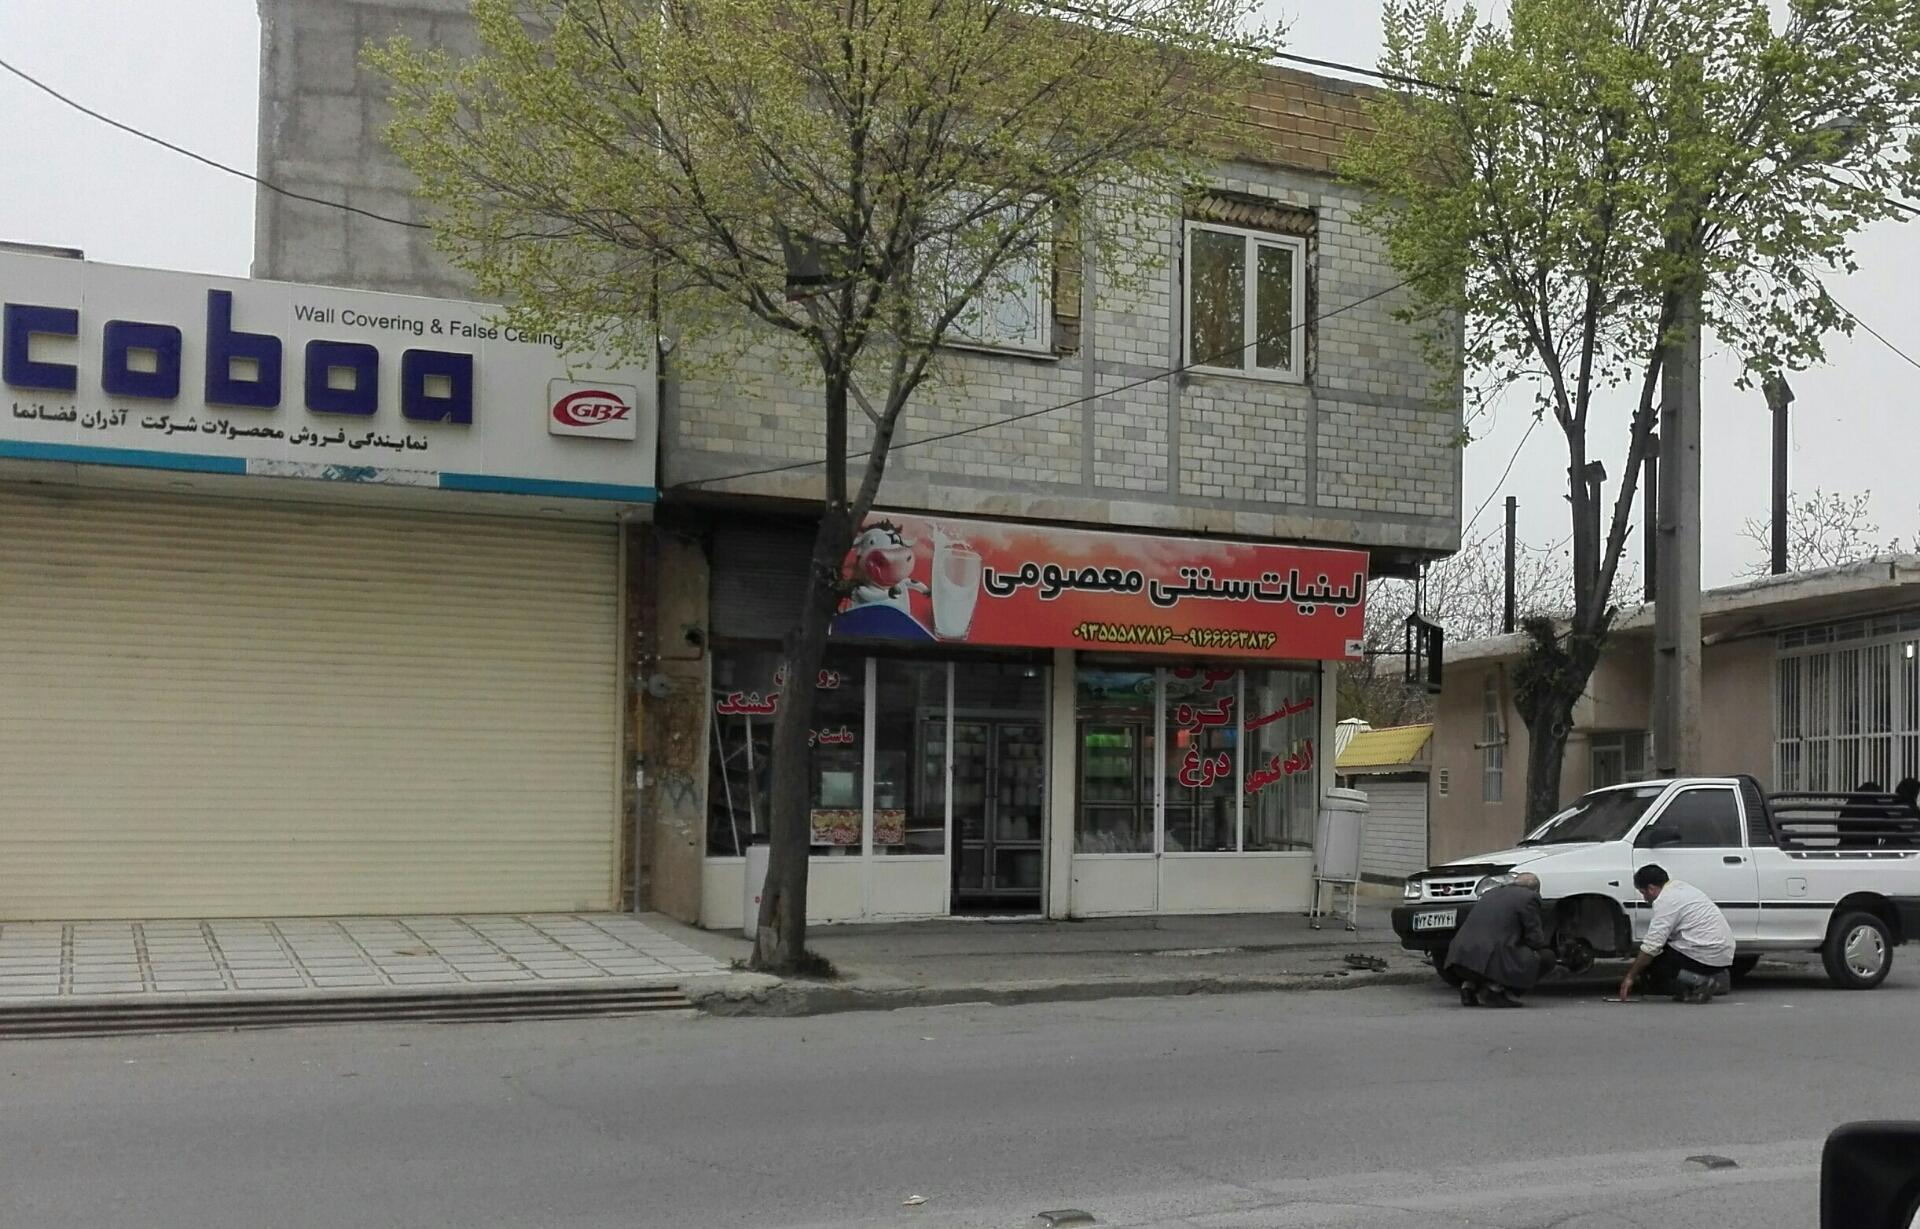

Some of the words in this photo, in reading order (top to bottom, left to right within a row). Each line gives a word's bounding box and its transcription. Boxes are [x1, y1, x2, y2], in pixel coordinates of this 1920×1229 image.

[294, 304, 335, 323] Wall
[341, 310, 424, 335] Covering
[430, 318, 443, 334] &
[449, 321, 498, 340] False
[12, 402, 77, 422] فضانما
[81, 409, 128, 429] آذران
[572, 403, 631, 420] GBZ
[141, 415, 198, 435] شرکت
[202, 419, 284, 440] محصولات
[290, 427, 345, 446] فروش
[348, 433, 428, 451] نمایندگی
[984, 562, 1144, 600] معصومی
[1149, 567, 1251, 608] سنتی
[1252, 569, 1364, 617] لبنیات
[716, 692, 780, 715] کشک
[1178, 695, 1234, 734] کره
[1243, 697, 1314, 731] ماست
[818, 725, 854, 744] ماست
[1179, 743, 1231, 787] دوغ
